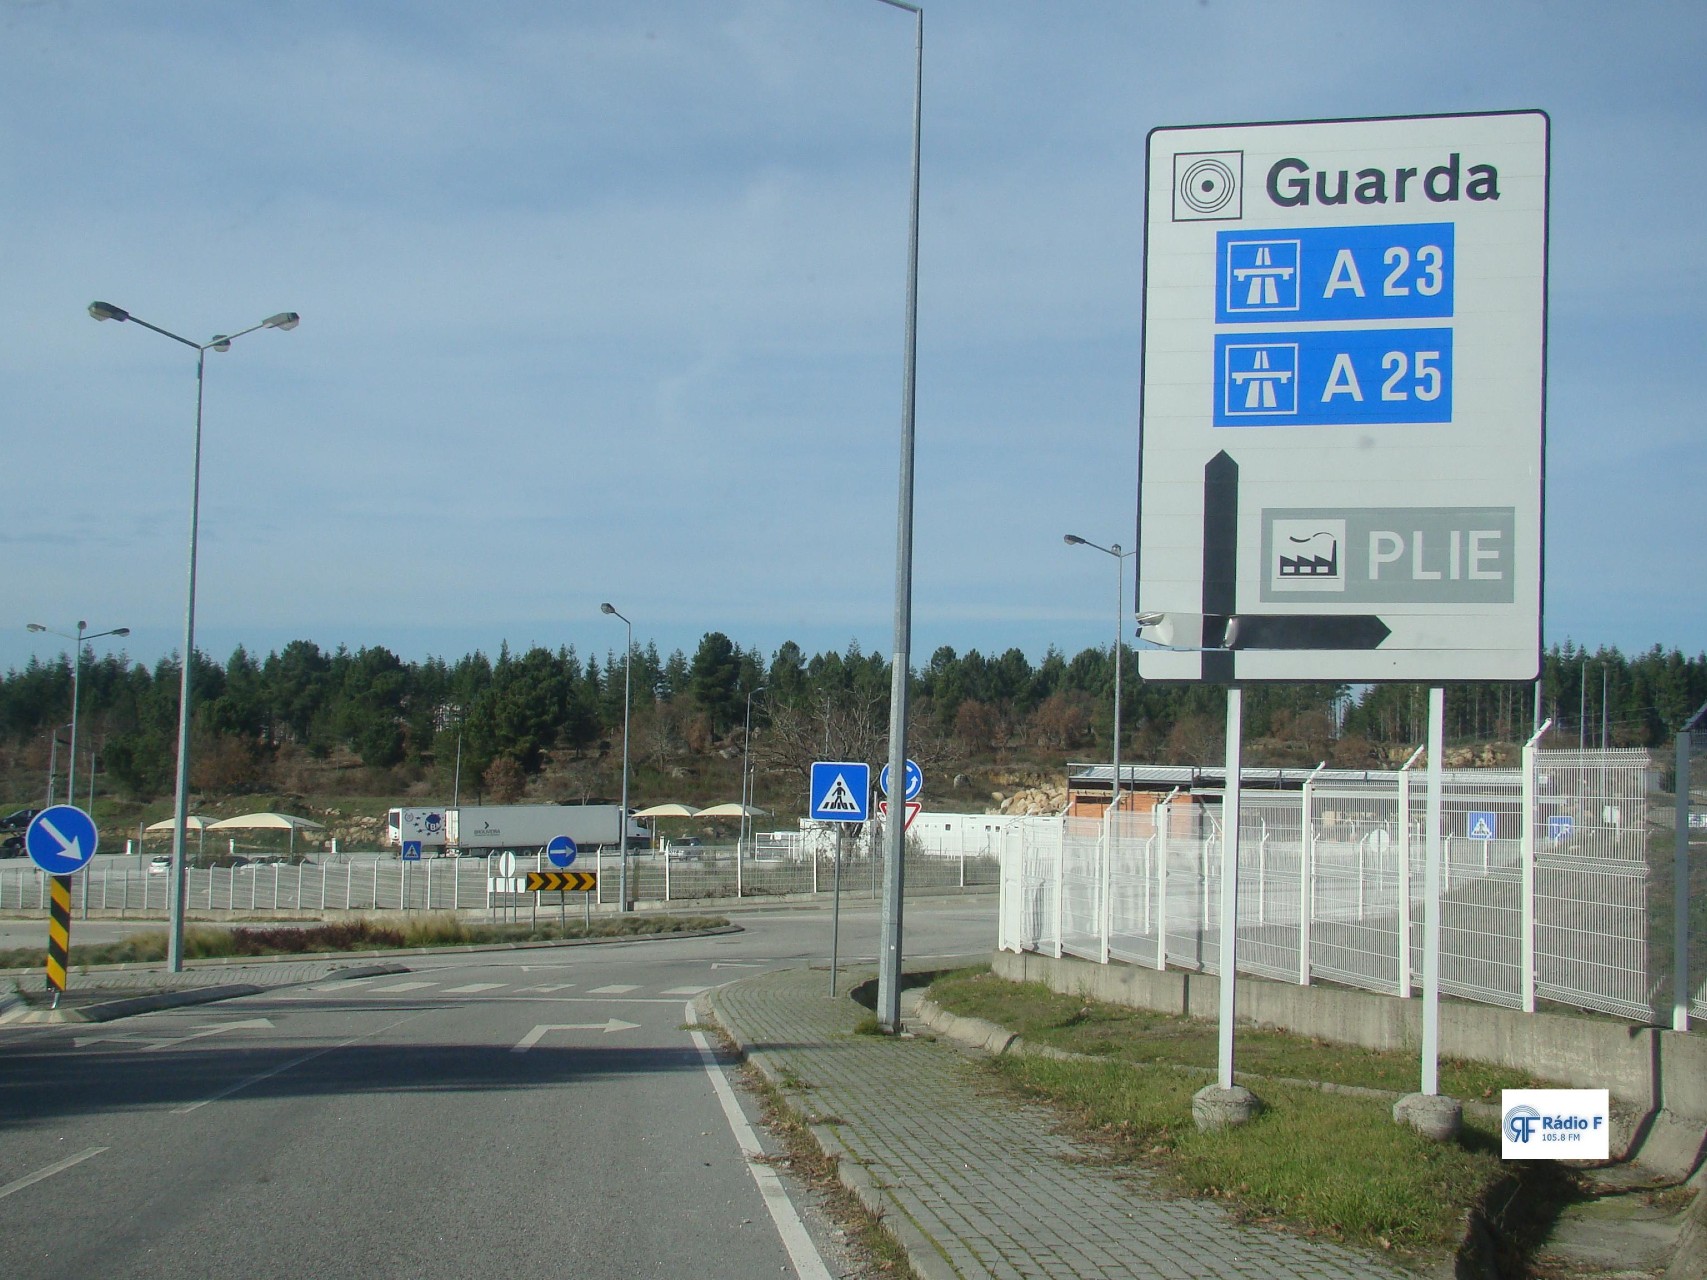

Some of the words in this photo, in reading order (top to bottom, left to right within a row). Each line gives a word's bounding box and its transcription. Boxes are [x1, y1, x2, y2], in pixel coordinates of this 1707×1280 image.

[1266, 153, 1501, 207] Guarda
[1323, 249, 1366, 299] A
[1383, 245, 1443, 297] 23
[1321, 353, 1364, 403] A
[1381, 350, 1441, 401] 25
[1369, 530, 1502, 580] PLIE
